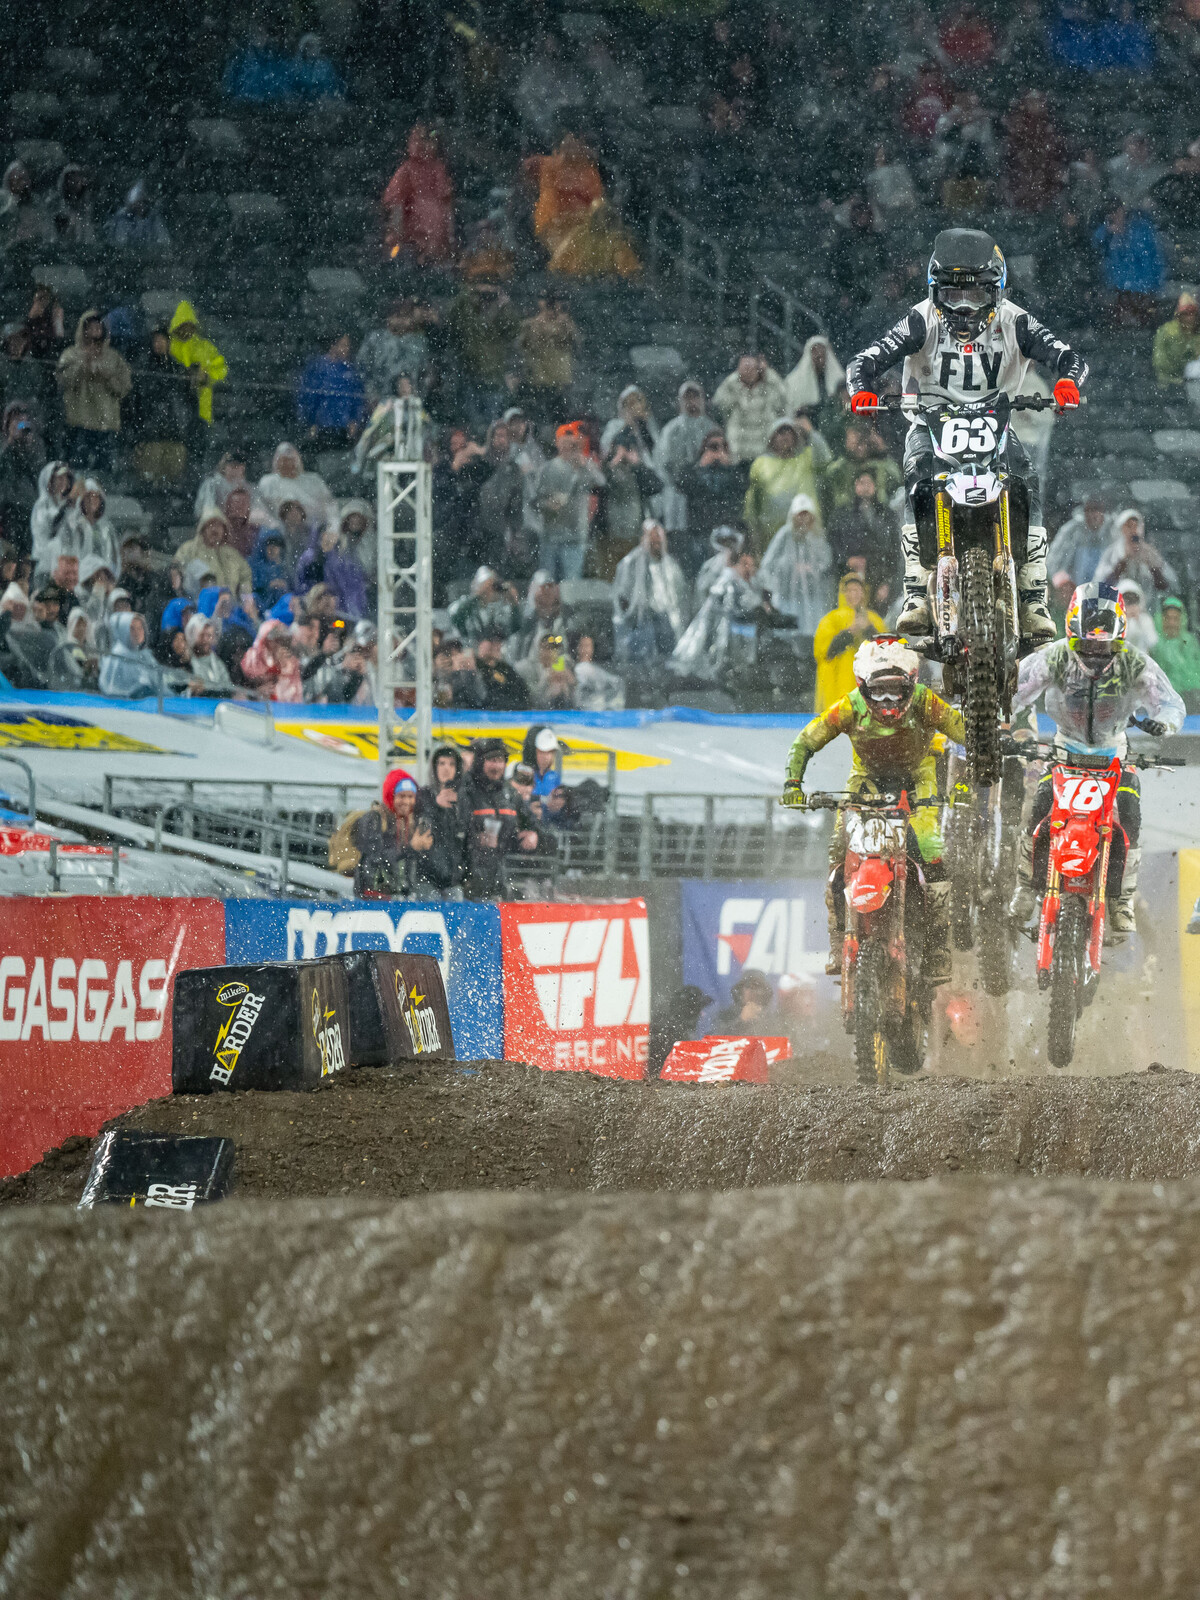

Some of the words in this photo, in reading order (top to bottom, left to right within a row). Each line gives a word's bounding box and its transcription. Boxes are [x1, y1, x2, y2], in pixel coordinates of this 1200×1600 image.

[955, 342, 985, 354] froth
[939, 351, 1003, 391] FLY
[940, 417, 999, 454] 63
[1058, 778, 1111, 811] 18
[0, 955, 168, 1042] GASGAS
[219, 985, 248, 1002] mike's
[555, 1034, 649, 1069] RACING
